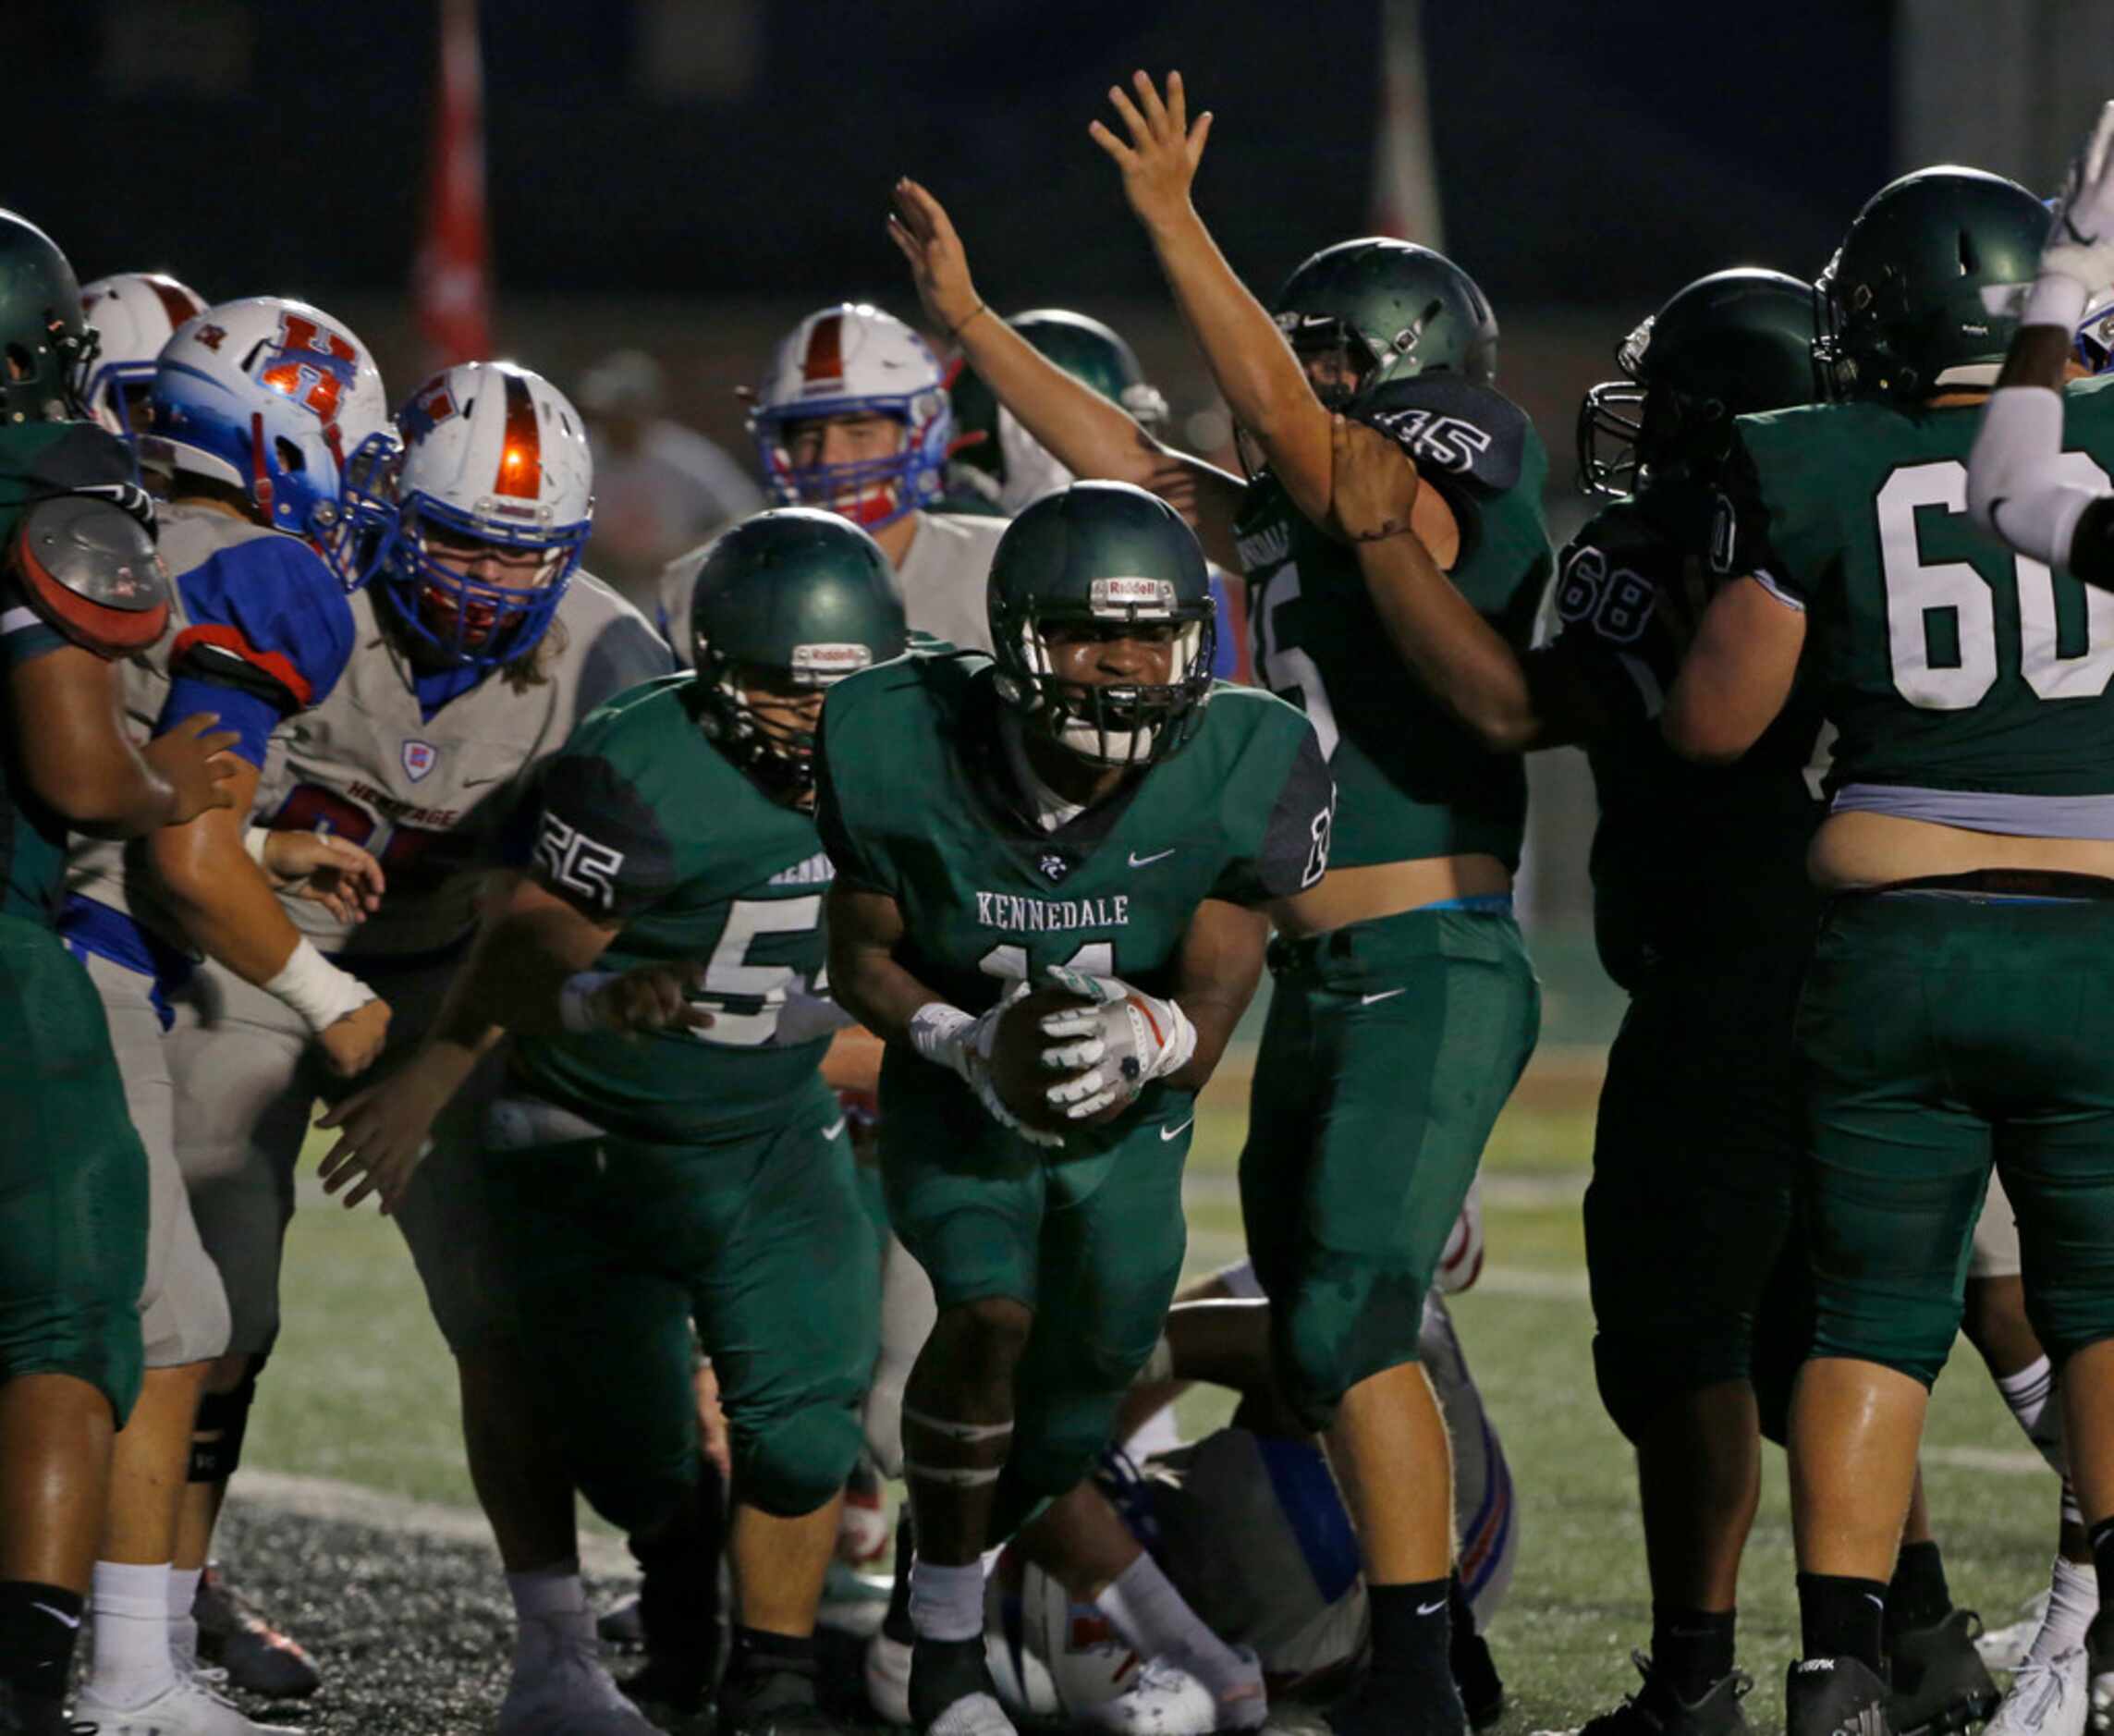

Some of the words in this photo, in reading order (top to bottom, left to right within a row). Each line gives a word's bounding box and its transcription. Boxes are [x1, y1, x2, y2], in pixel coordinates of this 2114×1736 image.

[1109, 581, 1155, 594] Riddell
[1556, 544, 1655, 642] 68
[1876, 450, 2114, 710] 60
[537, 811, 625, 909] 55
[975, 890, 1130, 932] KENNEDALE
